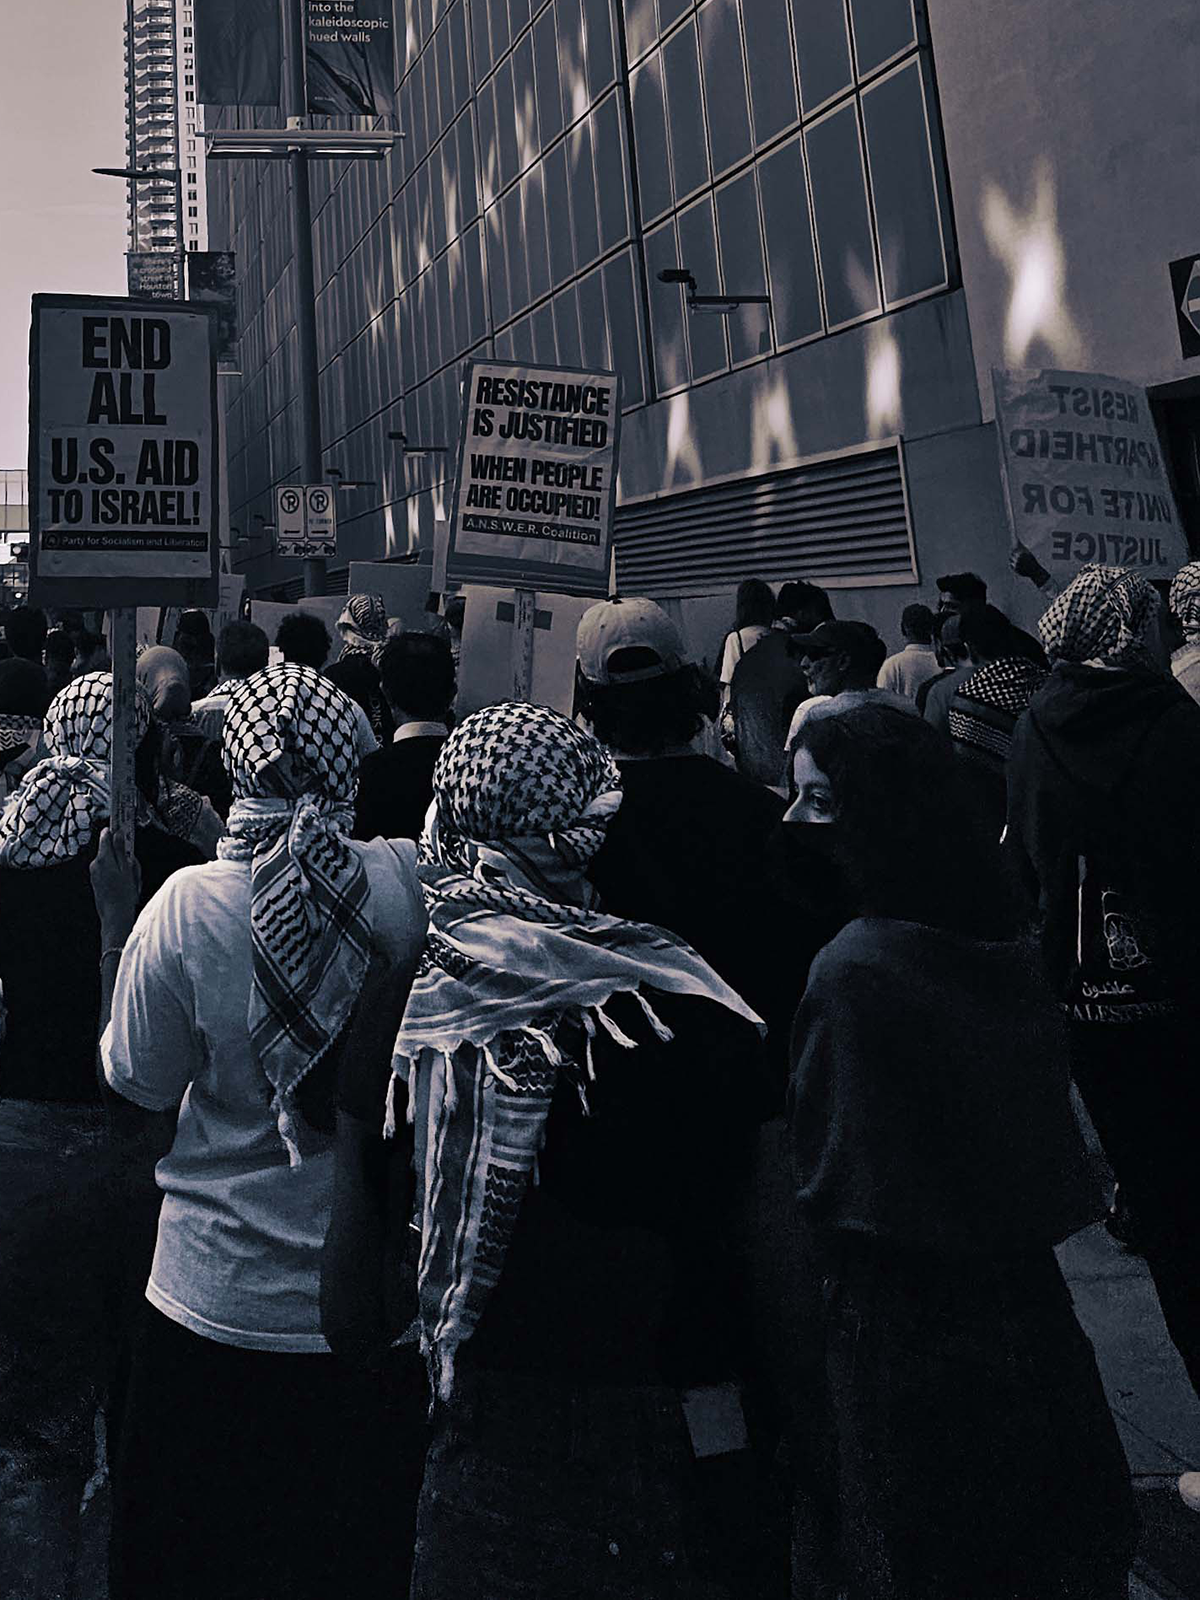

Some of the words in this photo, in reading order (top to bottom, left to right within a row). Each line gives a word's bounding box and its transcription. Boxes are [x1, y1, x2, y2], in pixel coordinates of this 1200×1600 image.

[309, 3, 330, 12] into
[334, 3, 354, 12] the
[309, 18, 389, 30] kaleidoscopic
[310, 32, 338, 42] hued
[342, 32, 371, 42] walls
[82, 317, 171, 370] END
[87, 372, 166, 425] ALL
[476, 377, 610, 416] RESISTANCE
[473, 409, 494, 437] IS
[500, 413, 607, 448] JUSTIFIED
[52, 438, 125, 485] U.S.
[136, 439, 199, 486] AID
[471, 454, 526, 483] WHEN
[531, 460, 602, 492] PEOPLE
[48, 489, 82, 524] TO
[92, 490, 200, 526] ISRAEL!
[466, 485, 501, 510] ARE
[506, 488, 601, 521] OCCUPIED!
[62, 536, 84, 546] Party
[87, 536, 100, 546] for
[101, 536, 144, 546] Socialism
[146, 537, 162, 546] and
[164, 537, 205, 547] Liberation
[466, 518, 538, 534] A.N.S.W.E.R.
[542, 526, 597, 542] Coalition
